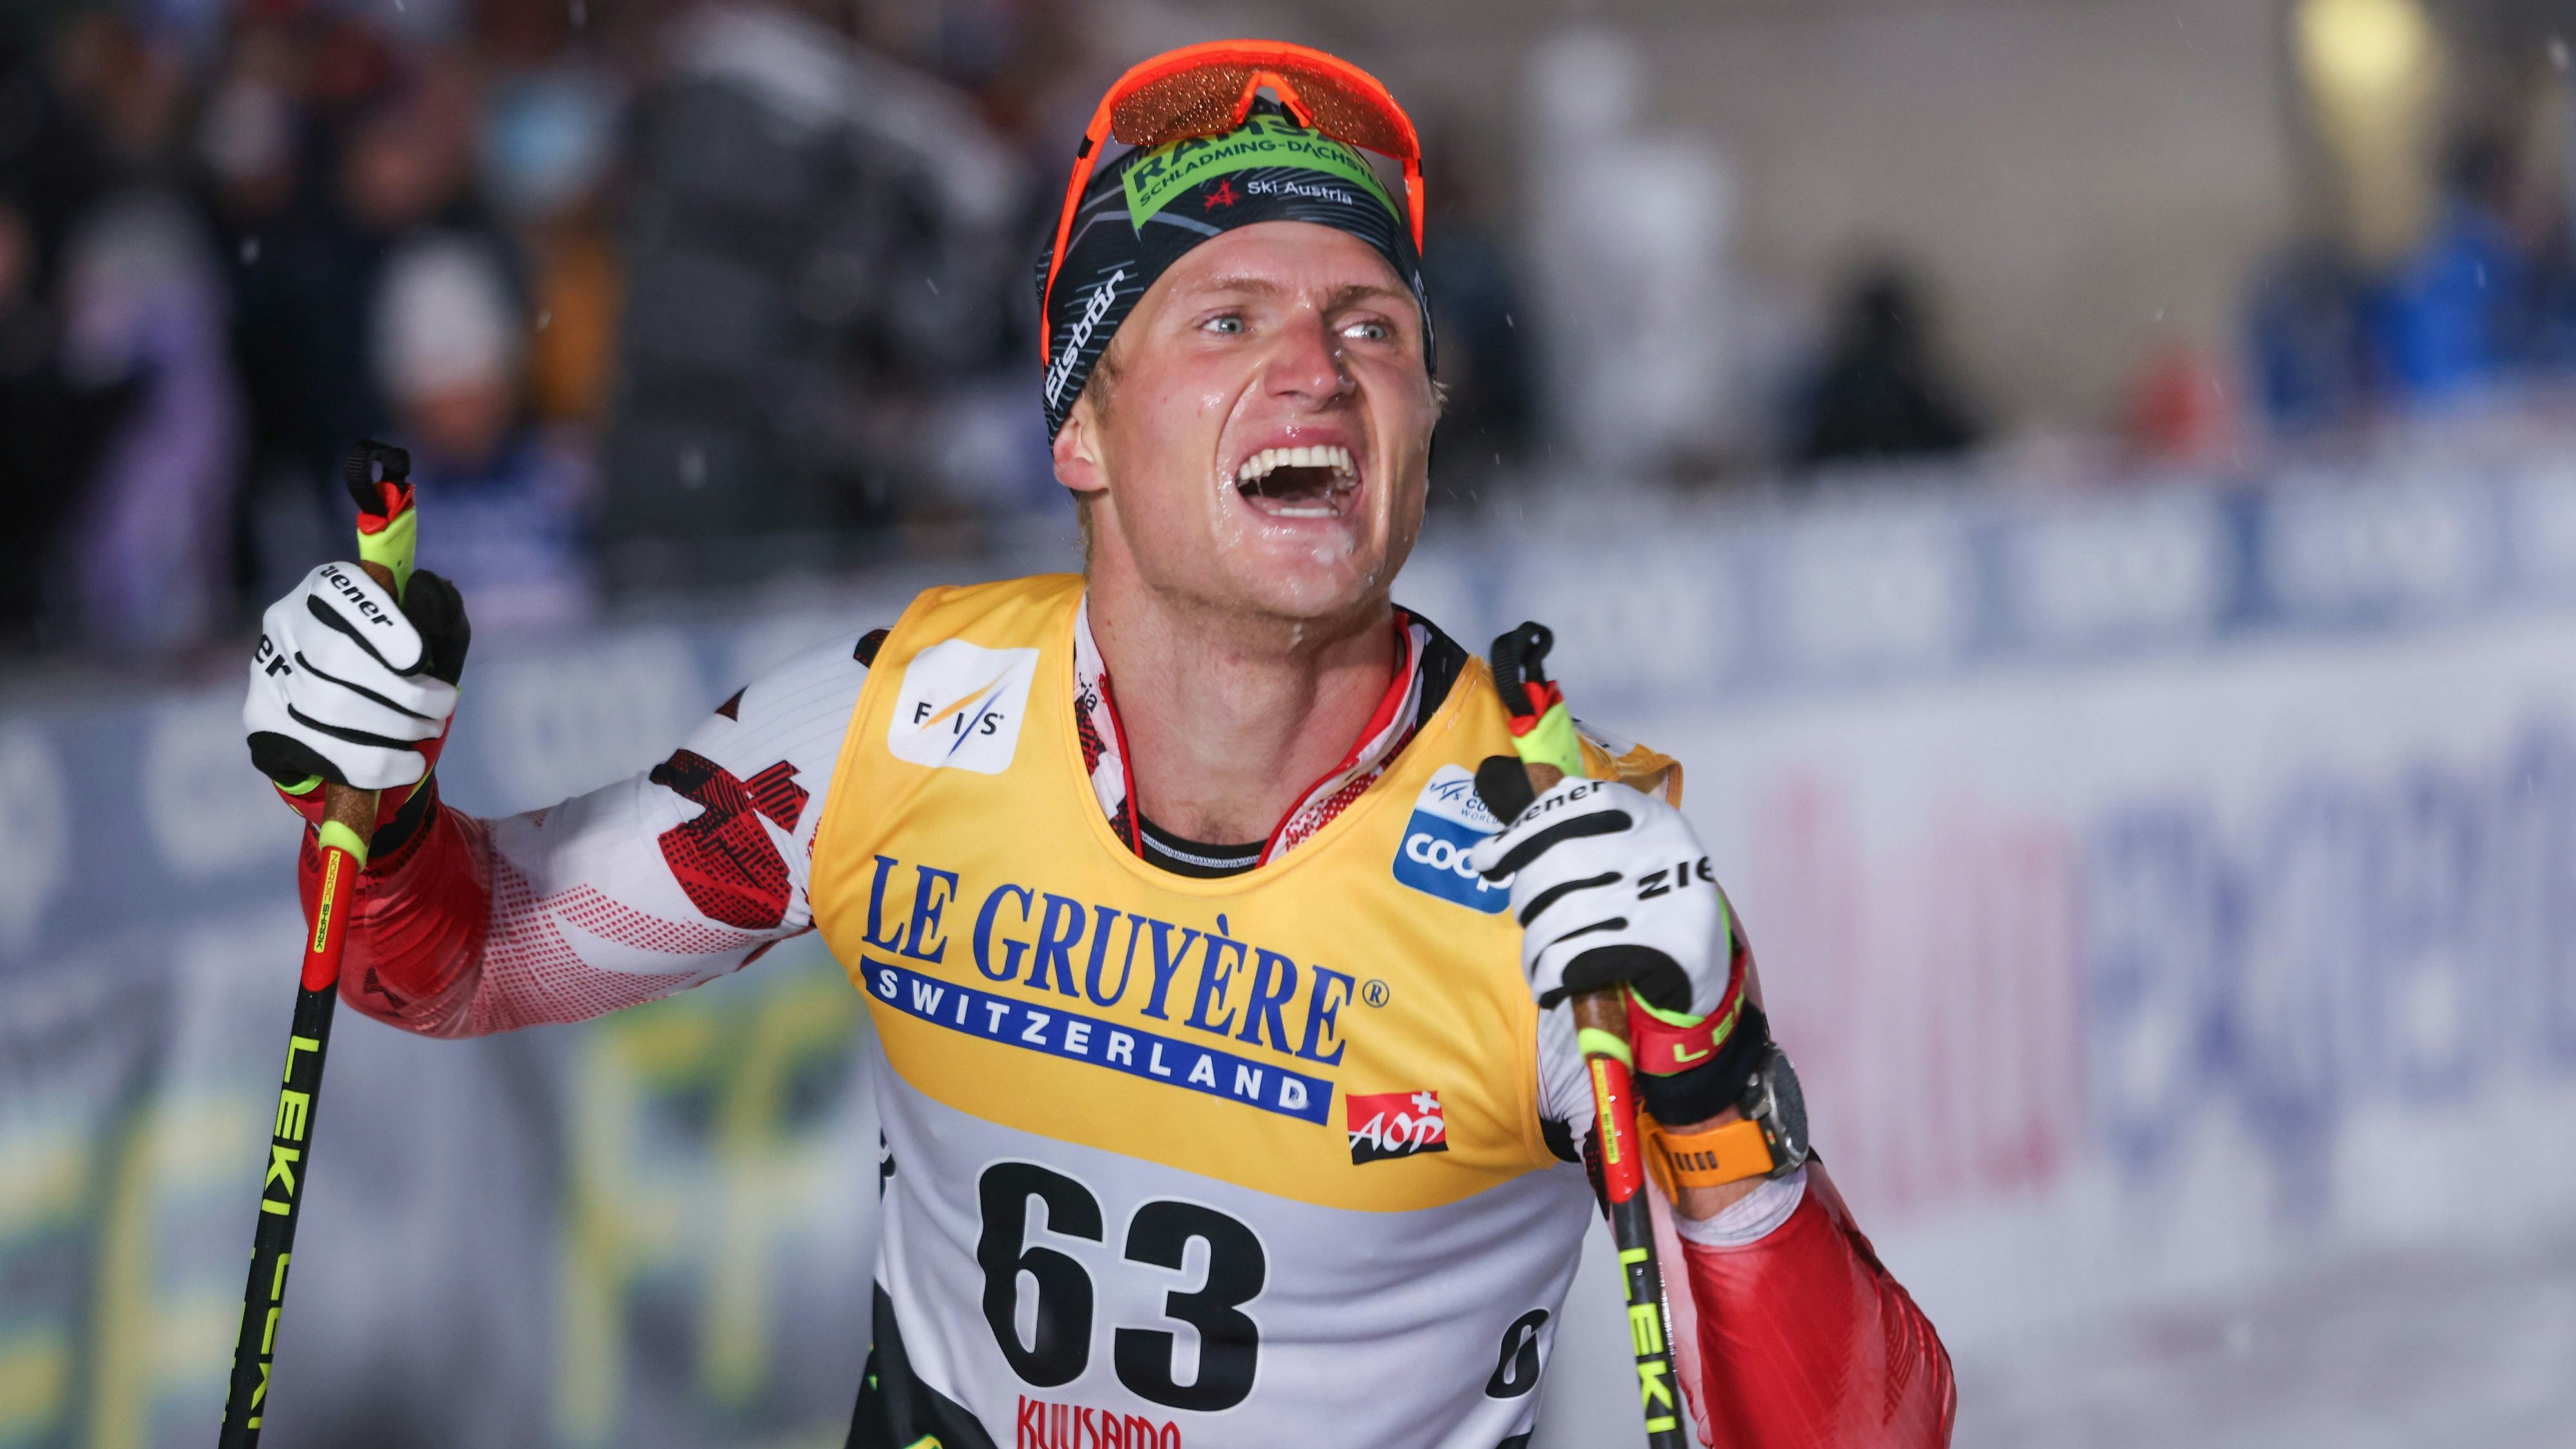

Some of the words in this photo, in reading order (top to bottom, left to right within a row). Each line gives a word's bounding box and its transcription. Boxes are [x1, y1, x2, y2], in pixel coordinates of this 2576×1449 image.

[1247, 180, 1278, 194] Ski
[1284, 181, 1352, 205] Austria
[1045, 269, 1126, 411] Eisbär
[913, 701, 999, 735] FIS
[316, 904, 330, 950] SHARK
[325, 853, 339, 901] NORDIC
[862, 854, 960, 964] LE
[878, 967, 1310, 1110] SWITZERLAND
[261, 1035, 320, 1217] LEKI
[1348, 1111, 1445, 1154] AOP
[976, 1160, 1268, 1412] 63
[1618, 1247, 1677, 1434] LEKI
